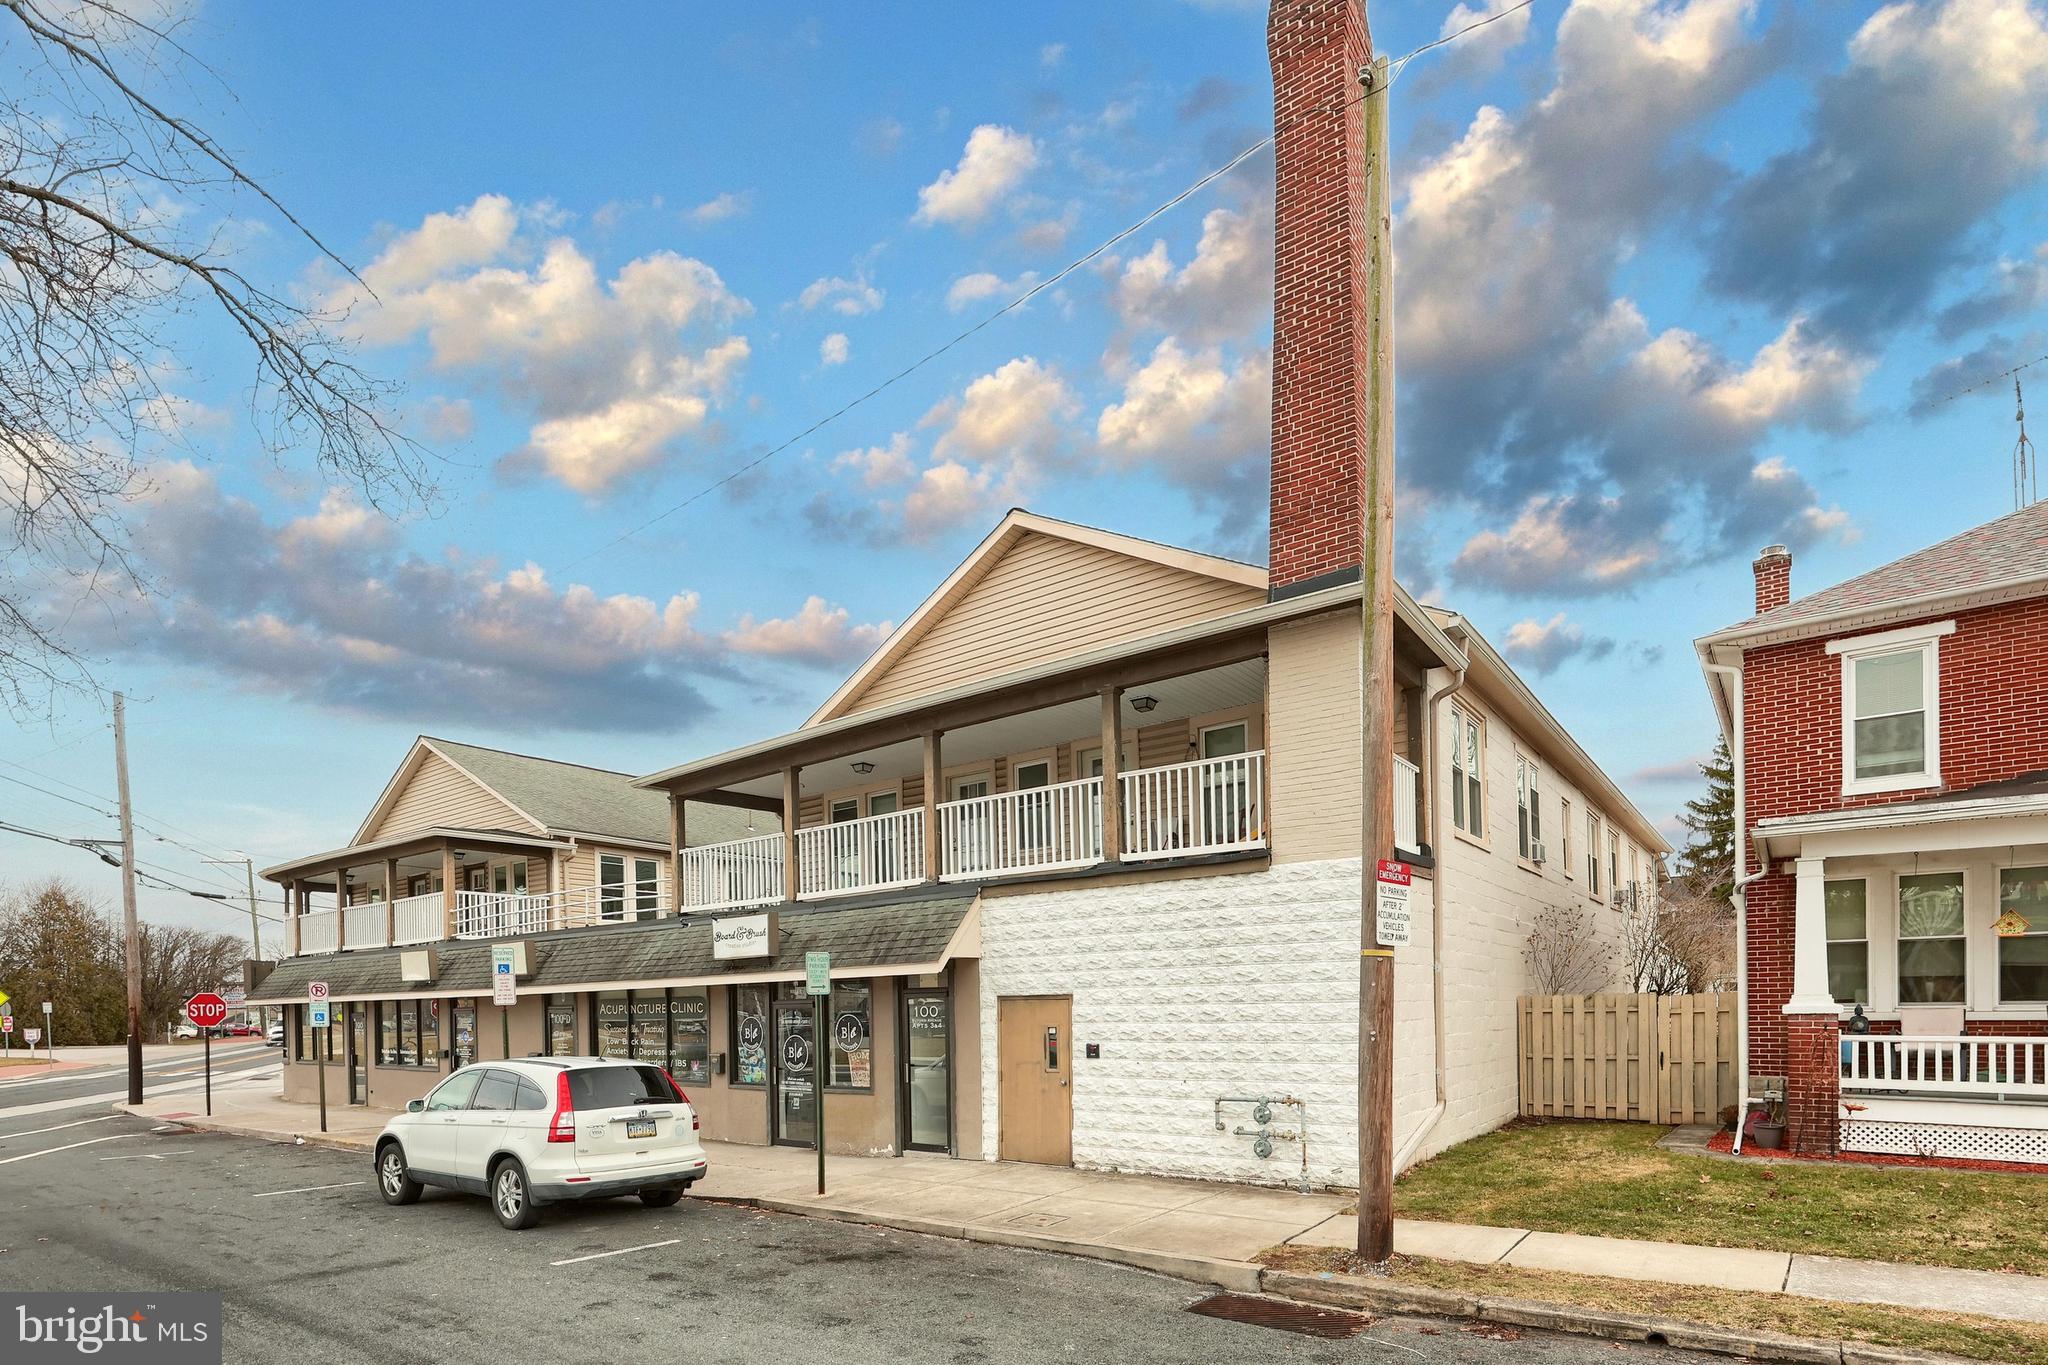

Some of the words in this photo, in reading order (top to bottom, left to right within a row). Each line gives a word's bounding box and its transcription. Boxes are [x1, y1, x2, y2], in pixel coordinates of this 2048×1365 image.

[1386, 862, 1402, 873] SNOW
[1379, 869, 1409, 882] EMERGENCY
[1380, 886, 1387, 894] NO
[1388, 886, 1408, 898] PARKING
[1383, 900, 1397, 910] AFTER
[1377, 910, 1411, 922] ACCUMULATION
[1382, 921, 1405, 932] VEHICLES
[714, 931, 736, 942] Board
[736, 926, 747, 941] &
[1379, 931, 1394, 941] TOWED
[1395, 933, 1409, 942] AWAY
[190, 1003, 225, 1017] STOP
[670, 1001, 704, 1014] CLINIC
[914, 1005, 939, 1018] 100
